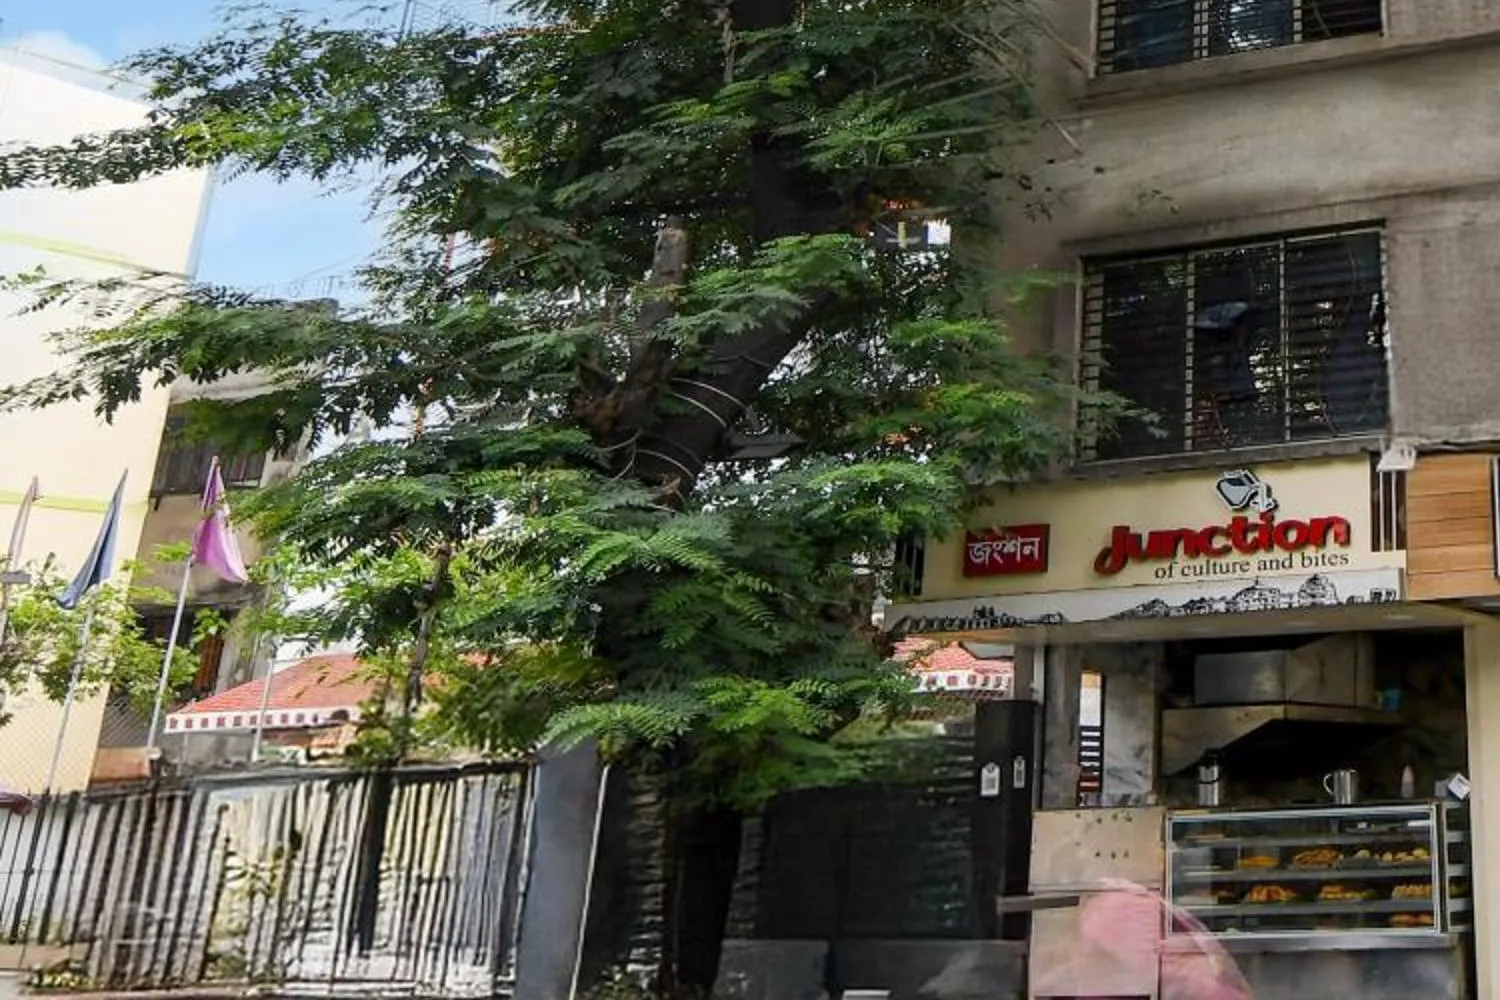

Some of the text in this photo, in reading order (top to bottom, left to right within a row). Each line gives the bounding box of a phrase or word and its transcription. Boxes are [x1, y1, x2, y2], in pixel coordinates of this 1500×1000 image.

[1093, 511, 1352, 576] Junction
[1154, 550, 1350, 580] of culture and bites
